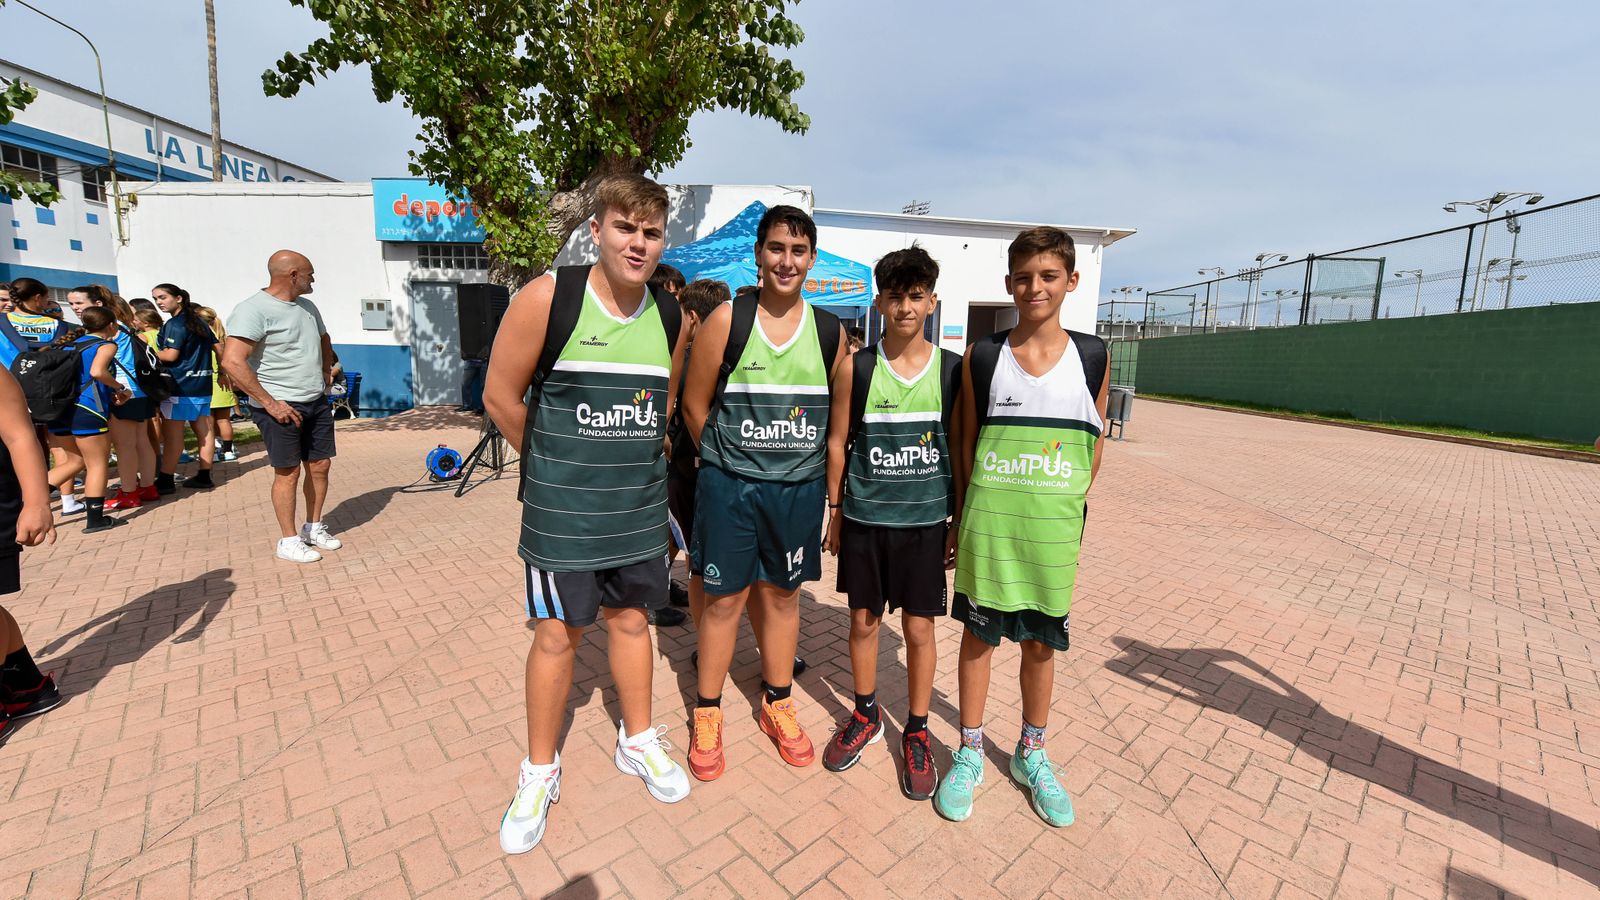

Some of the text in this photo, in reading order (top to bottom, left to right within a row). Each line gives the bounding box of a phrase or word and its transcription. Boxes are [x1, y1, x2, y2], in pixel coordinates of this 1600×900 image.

[144, 127, 271, 182] LA LNEA
[578, 427, 657, 438] FUNDACIÓN UNICAJA
[741, 440, 816, 450] FUNDACIÓN UNICAJA
[873, 465, 939, 476] FUNDACIÓN UNCAJA
[982, 475, 1070, 489] FUNDACIÓN UNICAJA
[785, 546, 804, 572] 14
